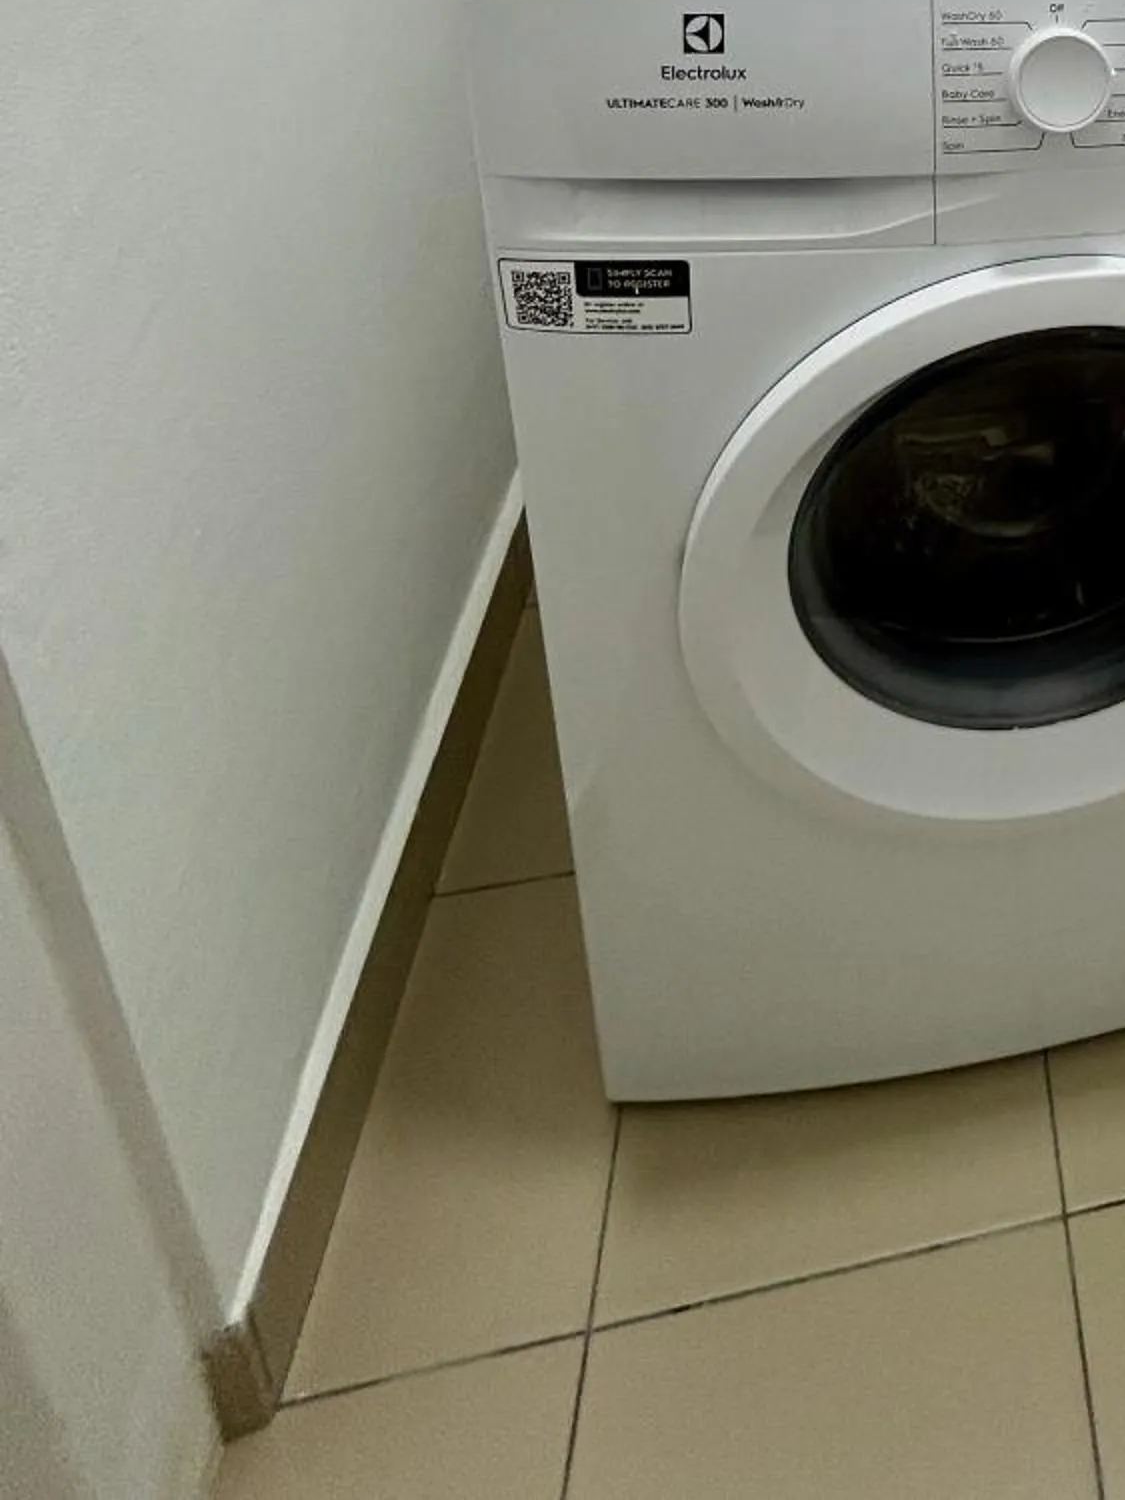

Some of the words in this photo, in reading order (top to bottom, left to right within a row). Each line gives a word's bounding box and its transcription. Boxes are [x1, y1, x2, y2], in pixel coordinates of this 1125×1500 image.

[660, 65, 748, 81] Electrolux
[606, 97, 701, 110] ULTIMATECARE
[704, 97, 729, 110] 300
[643, 268, 673, 278] SCAN
